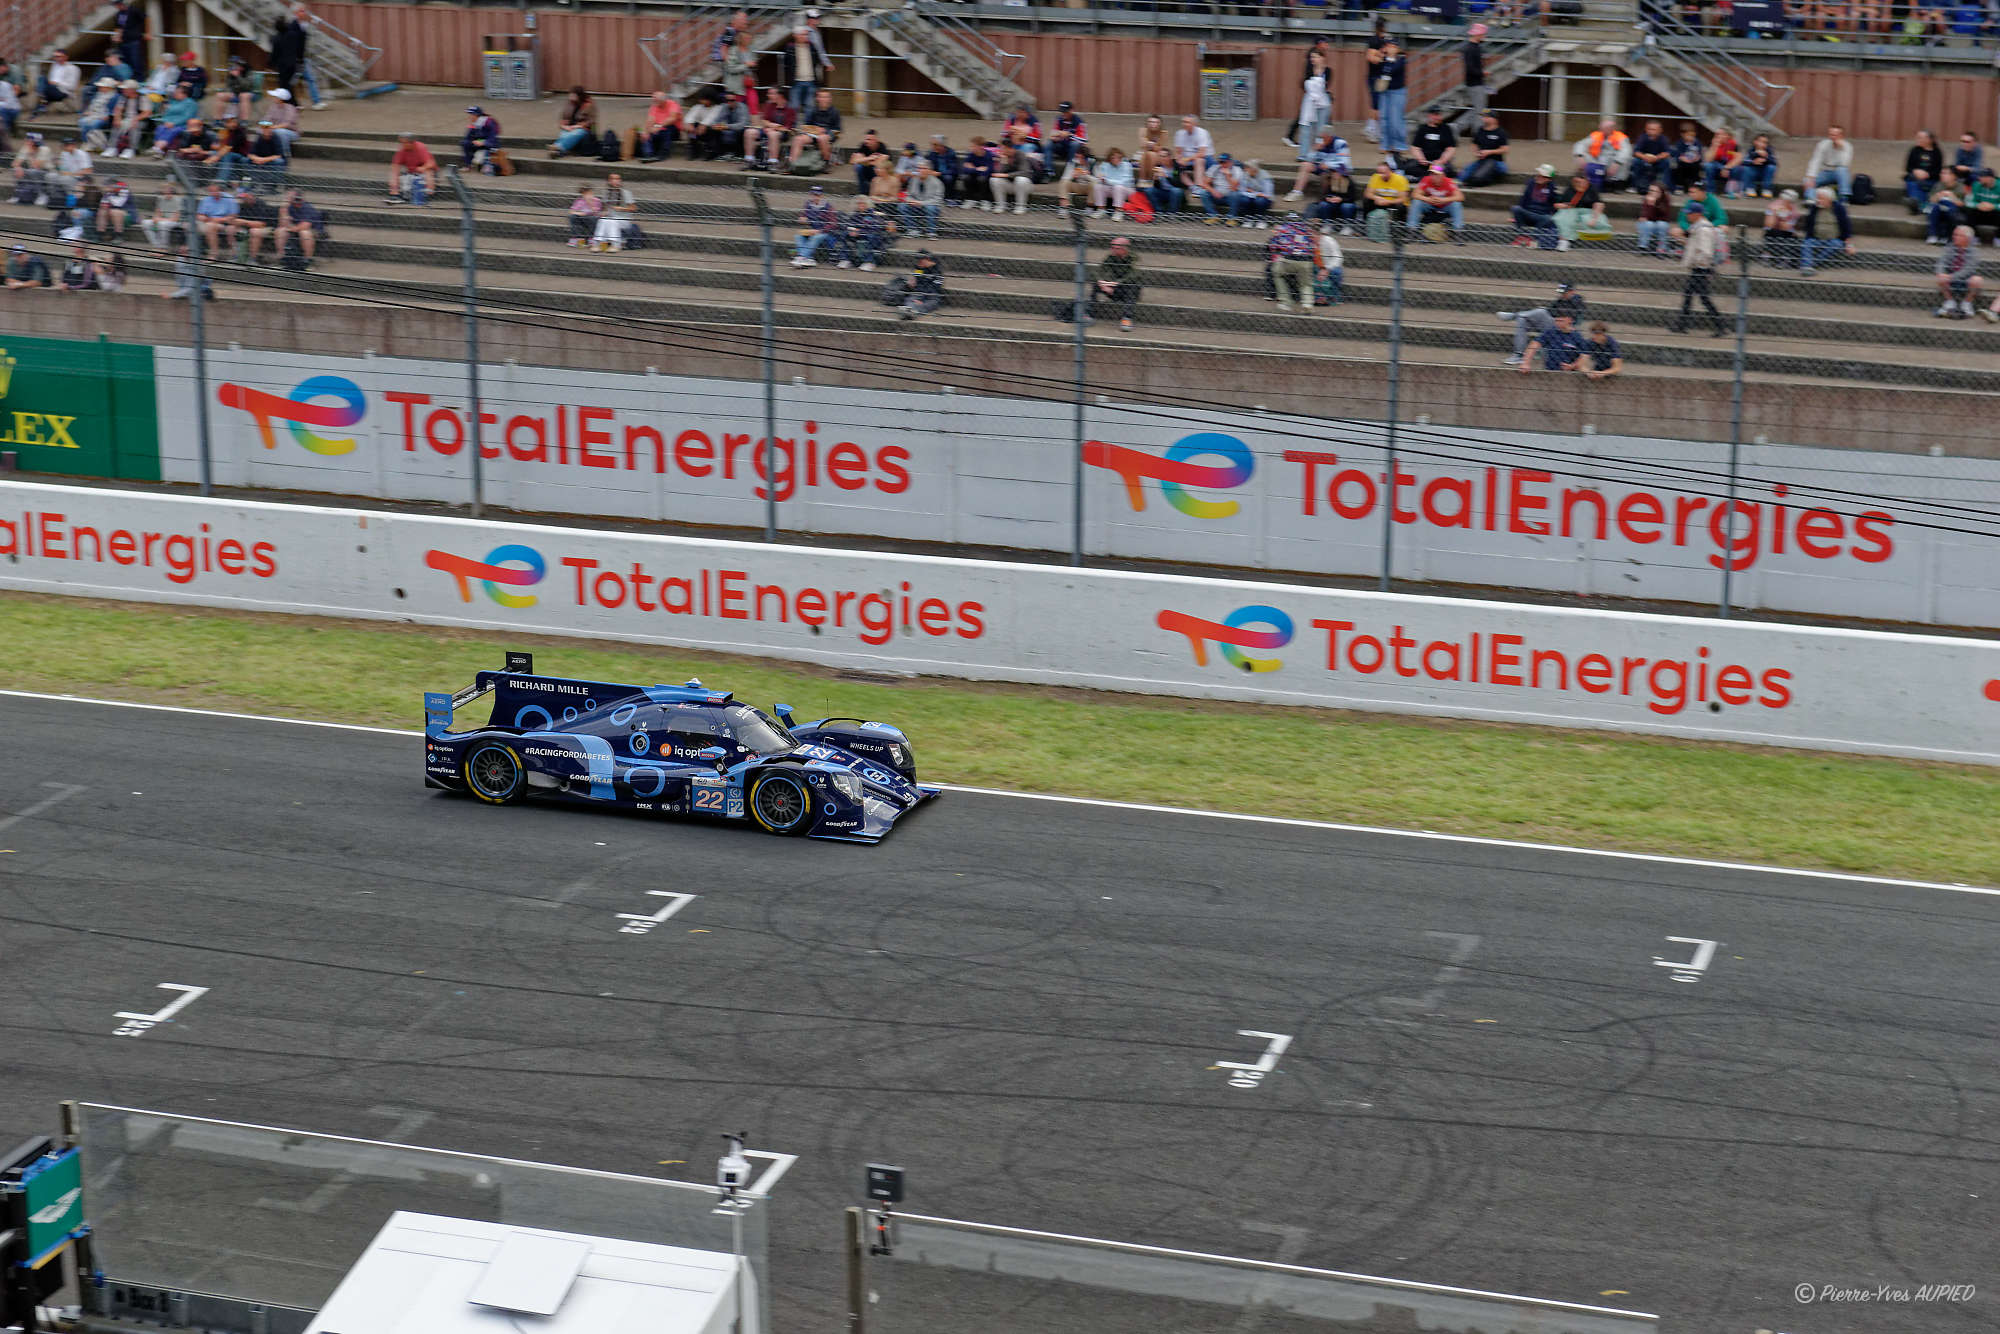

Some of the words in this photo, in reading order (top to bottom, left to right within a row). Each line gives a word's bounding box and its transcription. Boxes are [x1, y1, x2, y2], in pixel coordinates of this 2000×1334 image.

[386, 392, 910, 502] TotalEnergies
[1283, 450, 1894, 572] TotalEnergies
[563, 557, 985, 642] TotalEnergies
[1312, 619, 1792, 716] TotalEnergies
[509, 680, 555, 692] RICHARD
[557, 685, 589, 696] MILLE
[439, 743, 454, 752] option
[674, 745, 684, 758] iq
[811, 746, 833, 759] 22
[849, 742, 874, 751] WHEELS
[875, 744, 884, 752] UP
[525, 747, 610, 761] #RACINGFORDIABETES
[428, 766, 455, 774] GOODYEAR
[569, 774, 613, 784] GOODYEAR
[695, 789, 725, 810] 22
[728, 800, 743, 813] P2
[825, 820, 858, 828] GOODYEAR
